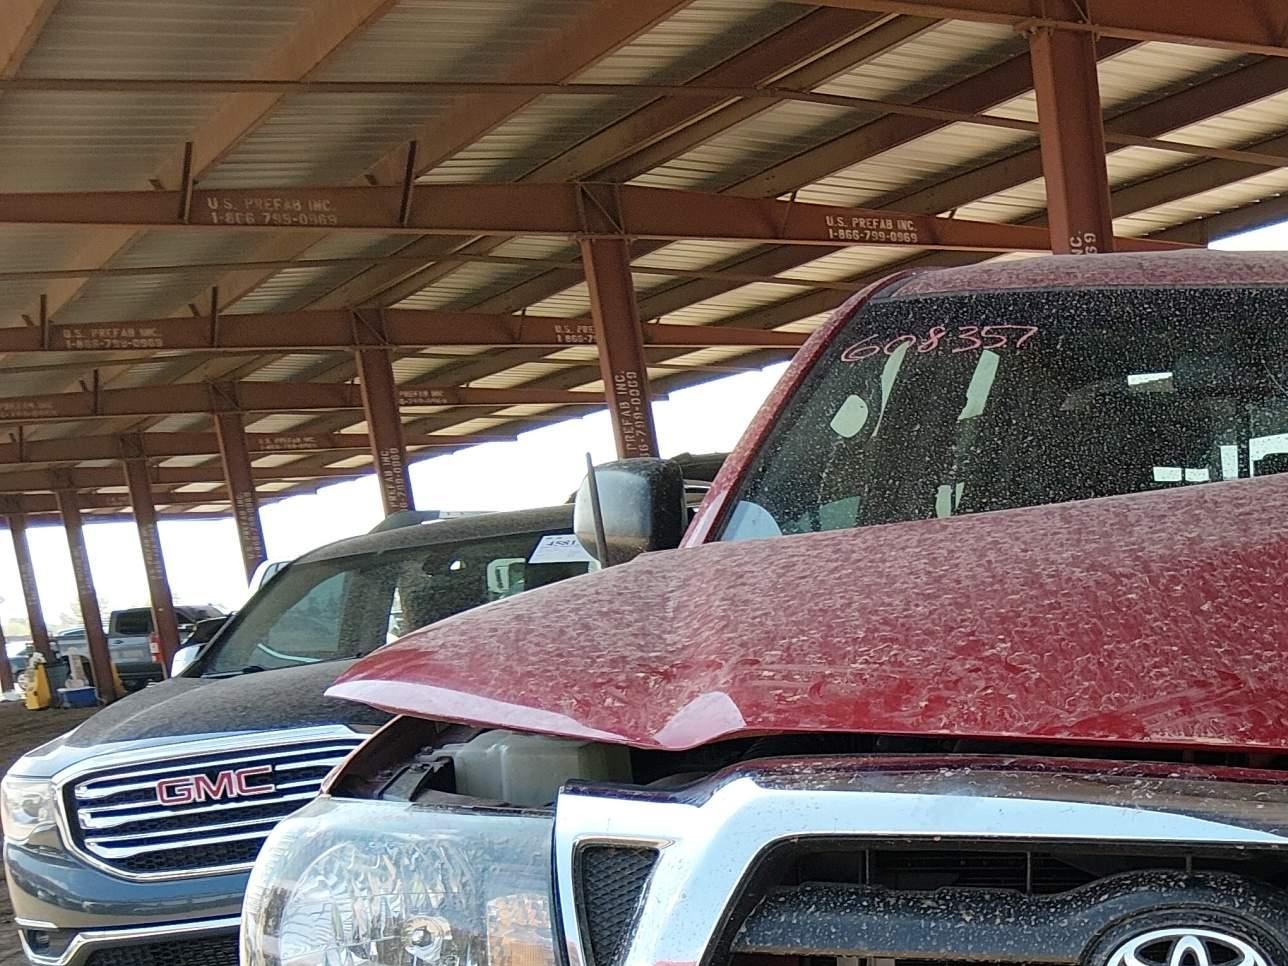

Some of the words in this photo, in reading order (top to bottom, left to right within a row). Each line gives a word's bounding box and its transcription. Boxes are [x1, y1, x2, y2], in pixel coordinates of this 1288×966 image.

[244, 198, 301, 211] PREFAB
[825, 215, 848, 228] U.S.
[852, 217, 893, 231] PREFAB
[896, 219, 918, 232] INC.
[828, 228, 918, 243] 1-866-799-0969
[840, 324, 1039, 362] 608357
[156, 764, 276, 806] GMC
